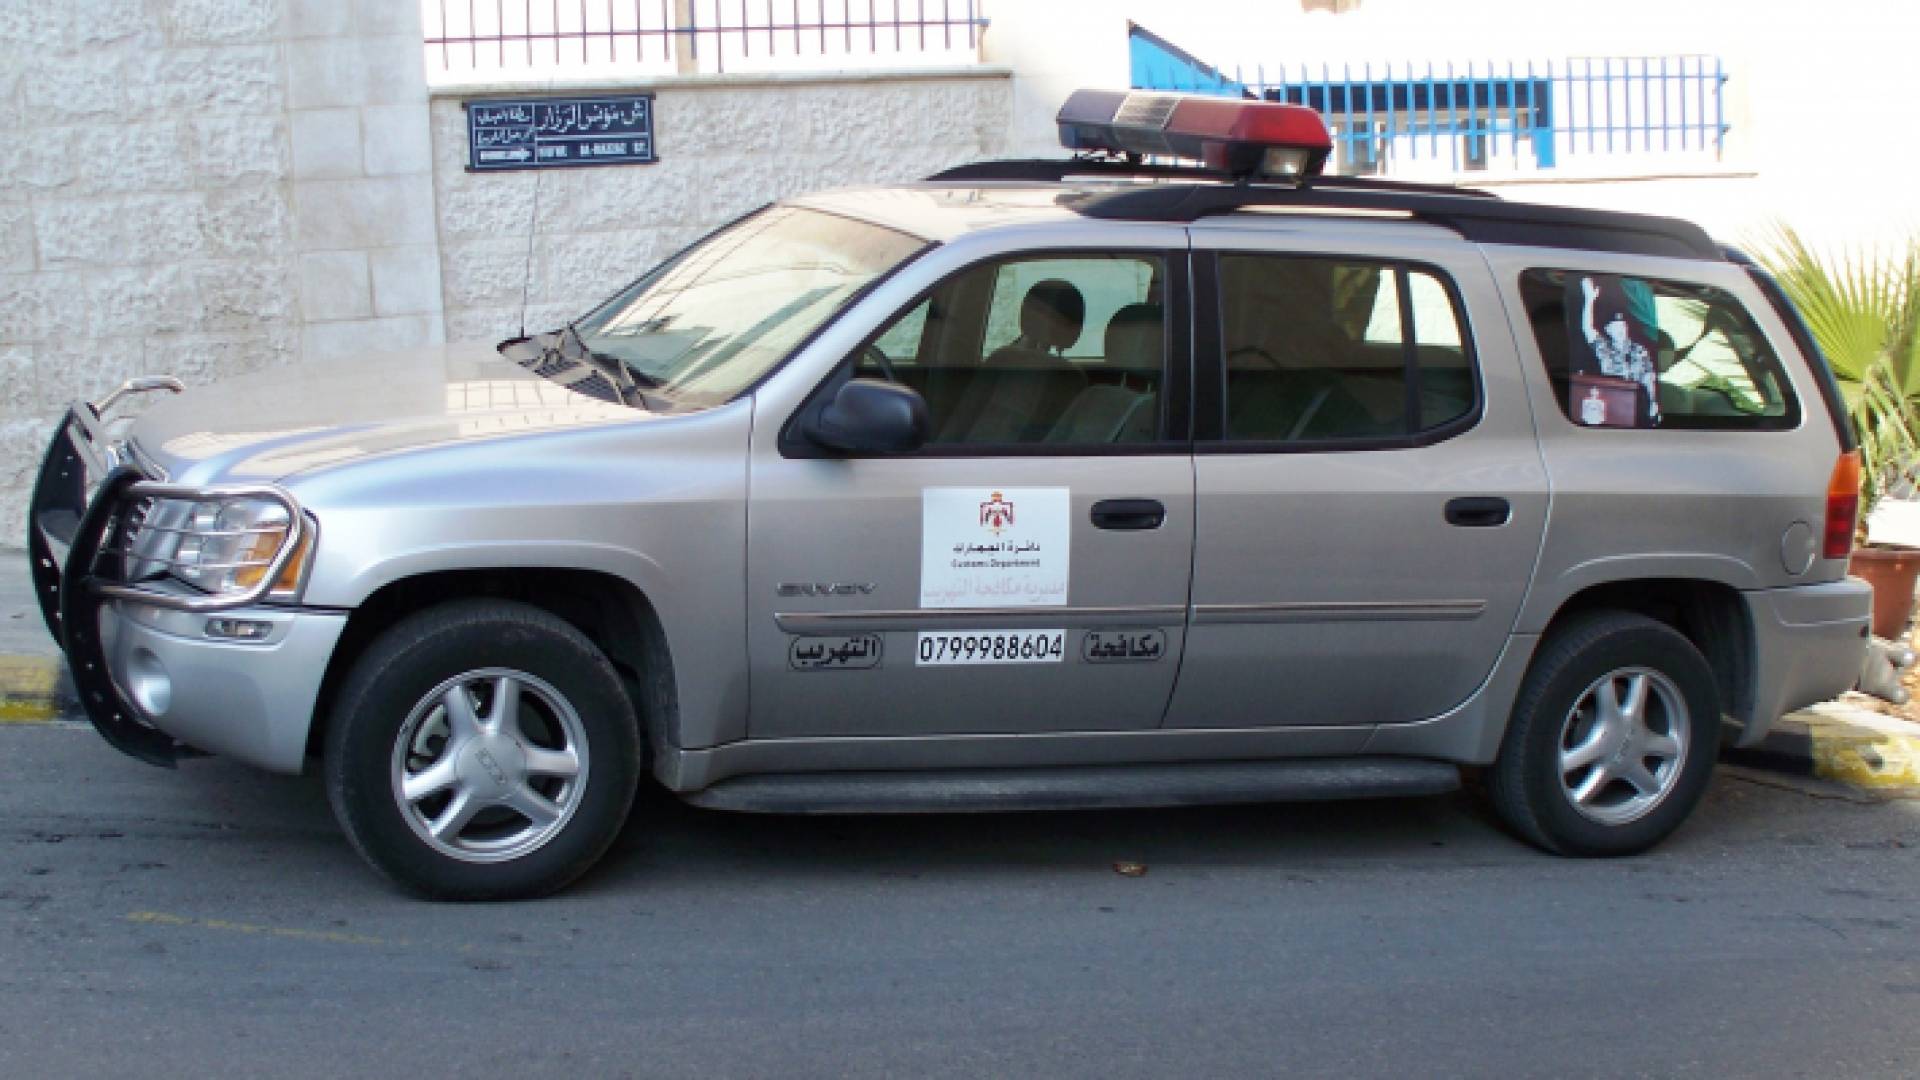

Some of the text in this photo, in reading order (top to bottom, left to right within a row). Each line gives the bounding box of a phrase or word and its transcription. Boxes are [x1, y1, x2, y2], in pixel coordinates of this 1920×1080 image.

[796, 636, 876, 666] التهريب
[919, 633, 1063, 662] 0799988604
[1090, 633, 1159, 657] مكافحة
